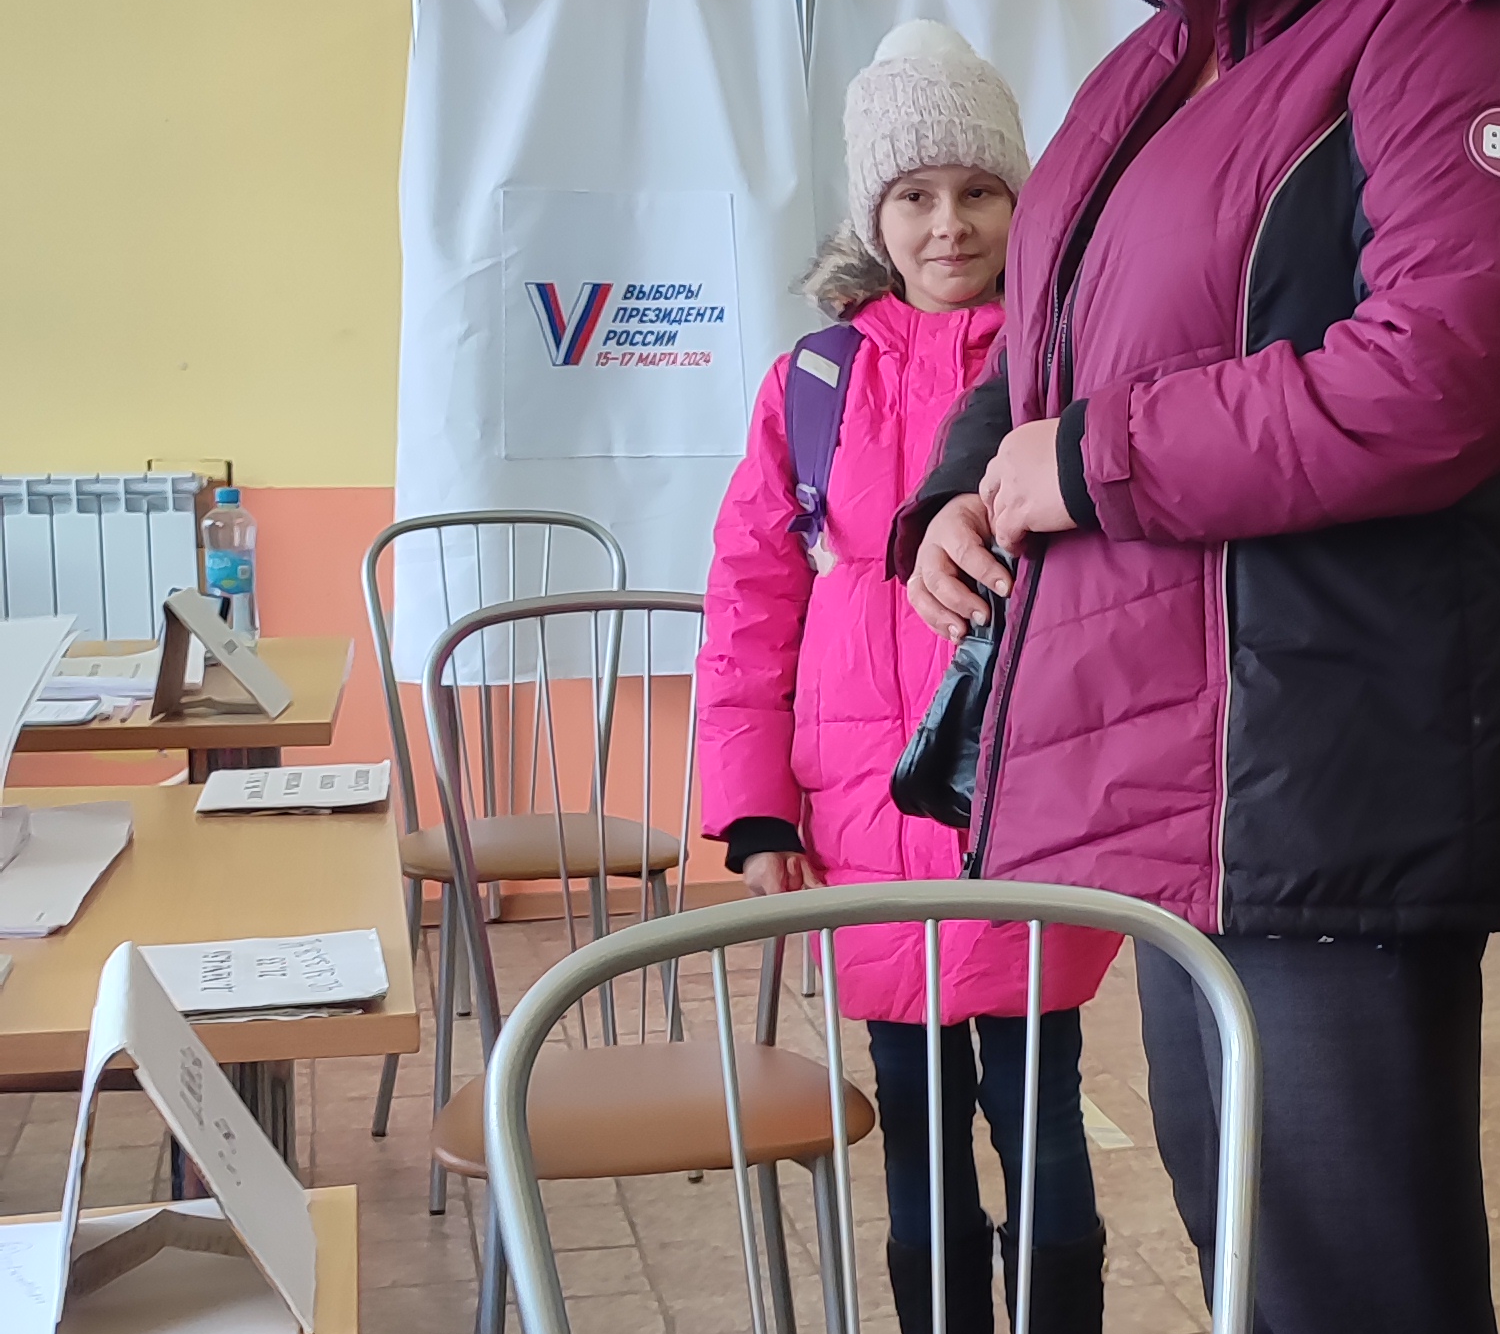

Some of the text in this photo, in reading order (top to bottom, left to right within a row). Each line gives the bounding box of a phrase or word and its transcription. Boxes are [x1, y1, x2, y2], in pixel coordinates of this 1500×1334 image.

[621, 283, 703, 301] ВЫБОРЫ
[611, 306, 725, 325] ПРЕЗИДЕНТА
[602, 329, 679, 347] РОССИИ
[635, 352, 679, 367] МАРТА
[680, 351, 713, 367] 2024
